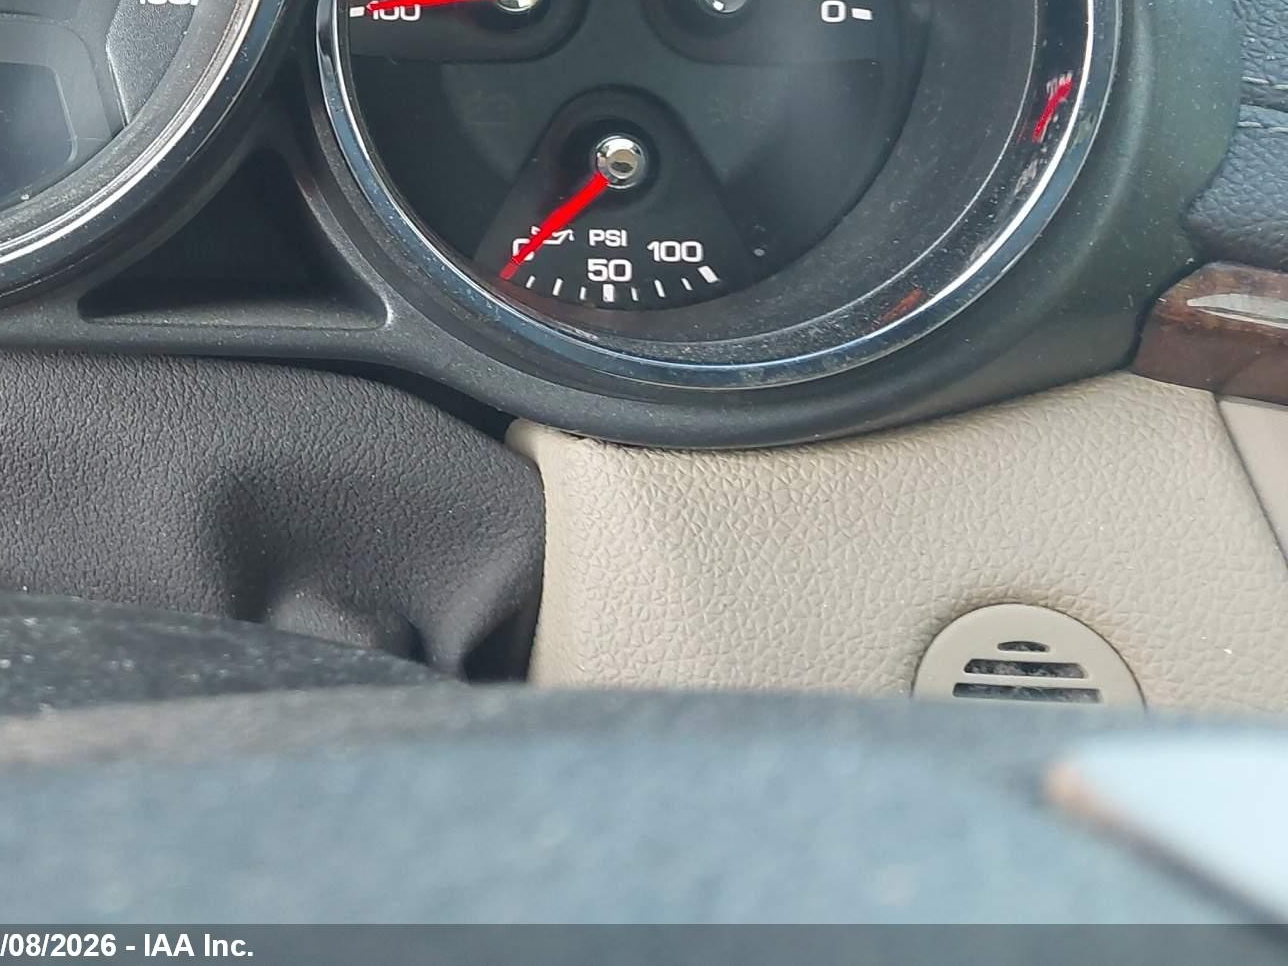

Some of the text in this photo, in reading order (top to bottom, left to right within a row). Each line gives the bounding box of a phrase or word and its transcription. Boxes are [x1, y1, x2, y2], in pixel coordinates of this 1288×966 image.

[820, 0, 847, 23] 0
[588, 228, 629, 248] PSI
[646, 240, 704, 263] 100
[586, 258, 633, 282] 50
